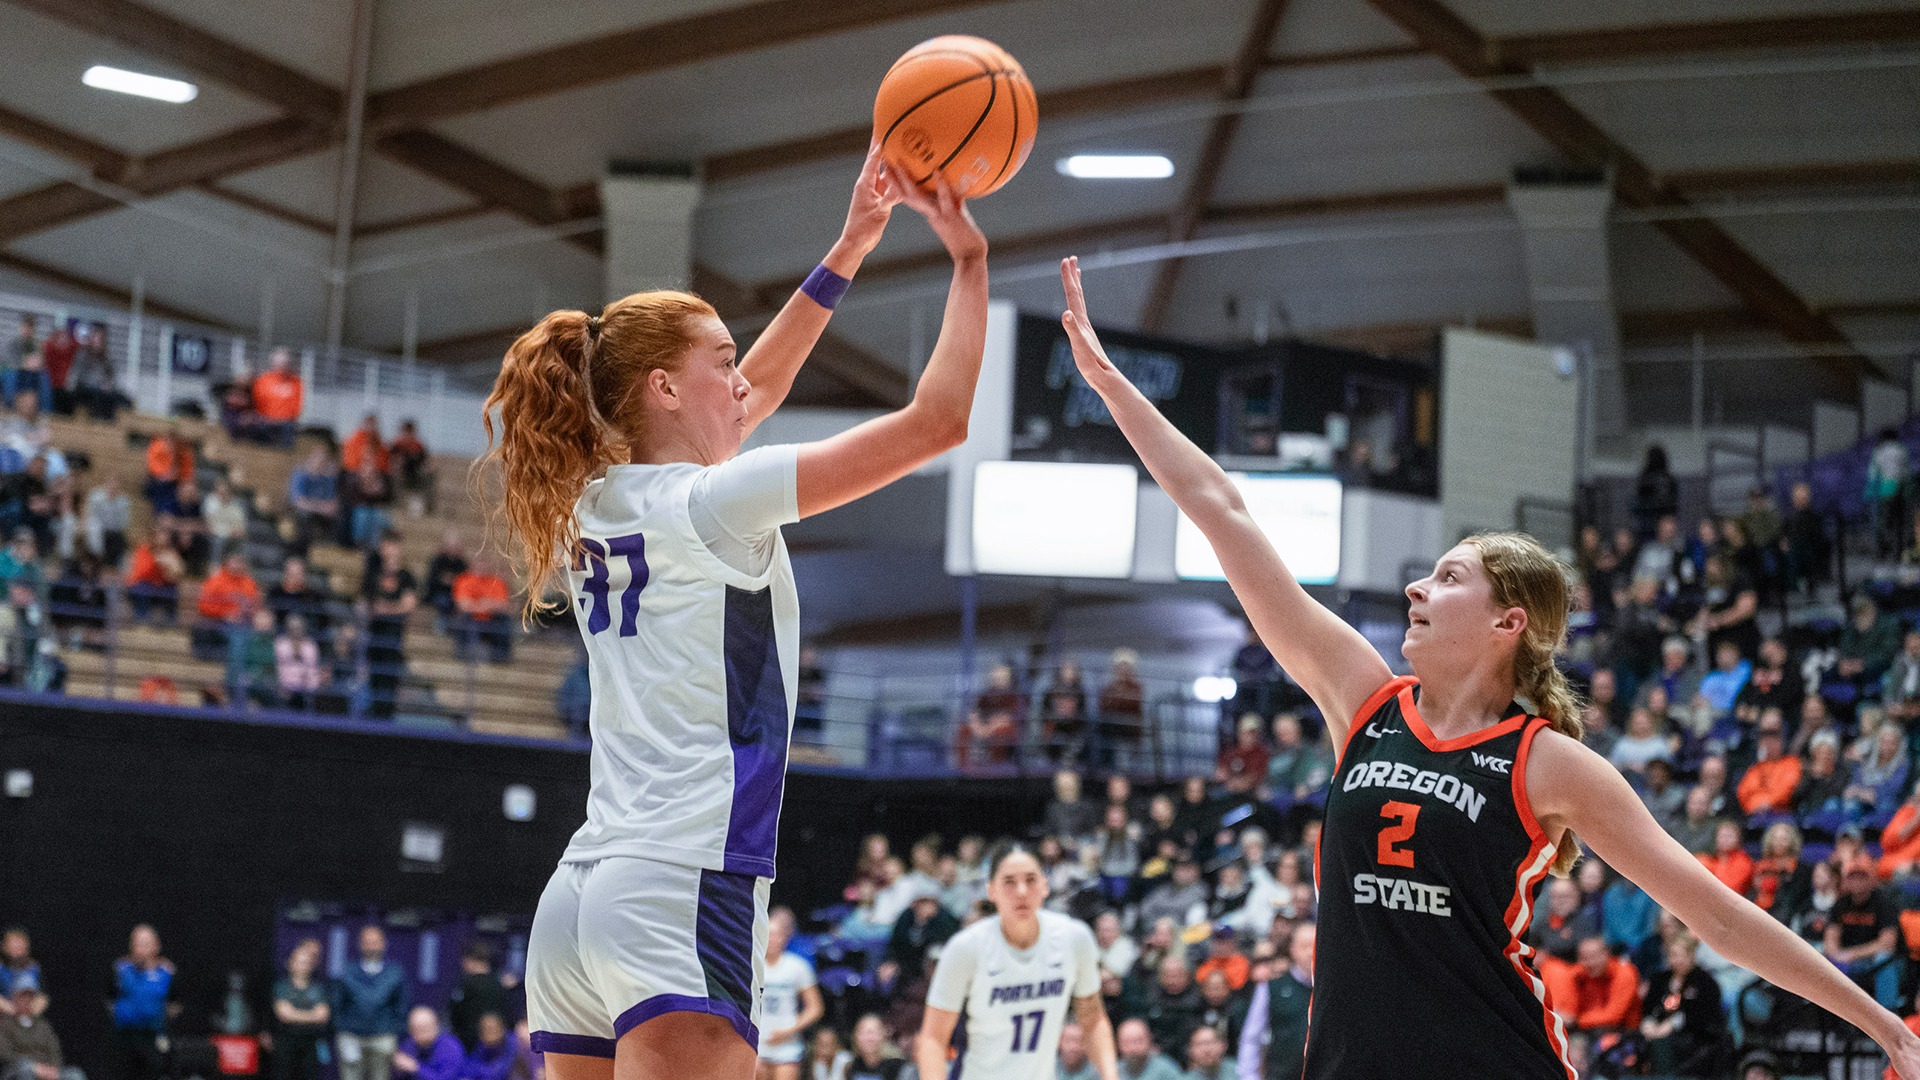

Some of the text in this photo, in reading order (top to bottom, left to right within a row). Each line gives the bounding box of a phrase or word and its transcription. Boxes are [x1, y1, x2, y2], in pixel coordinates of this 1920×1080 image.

[571, 533, 649, 637] 37
[1471, 751, 1512, 774] WCC
[1343, 761, 1486, 823] OREGON
[1377, 800, 1421, 868] 2
[1354, 874, 1451, 917] STATE
[989, 978, 1065, 1007] PORTLAND
[1011, 1010, 1045, 1052] 17
